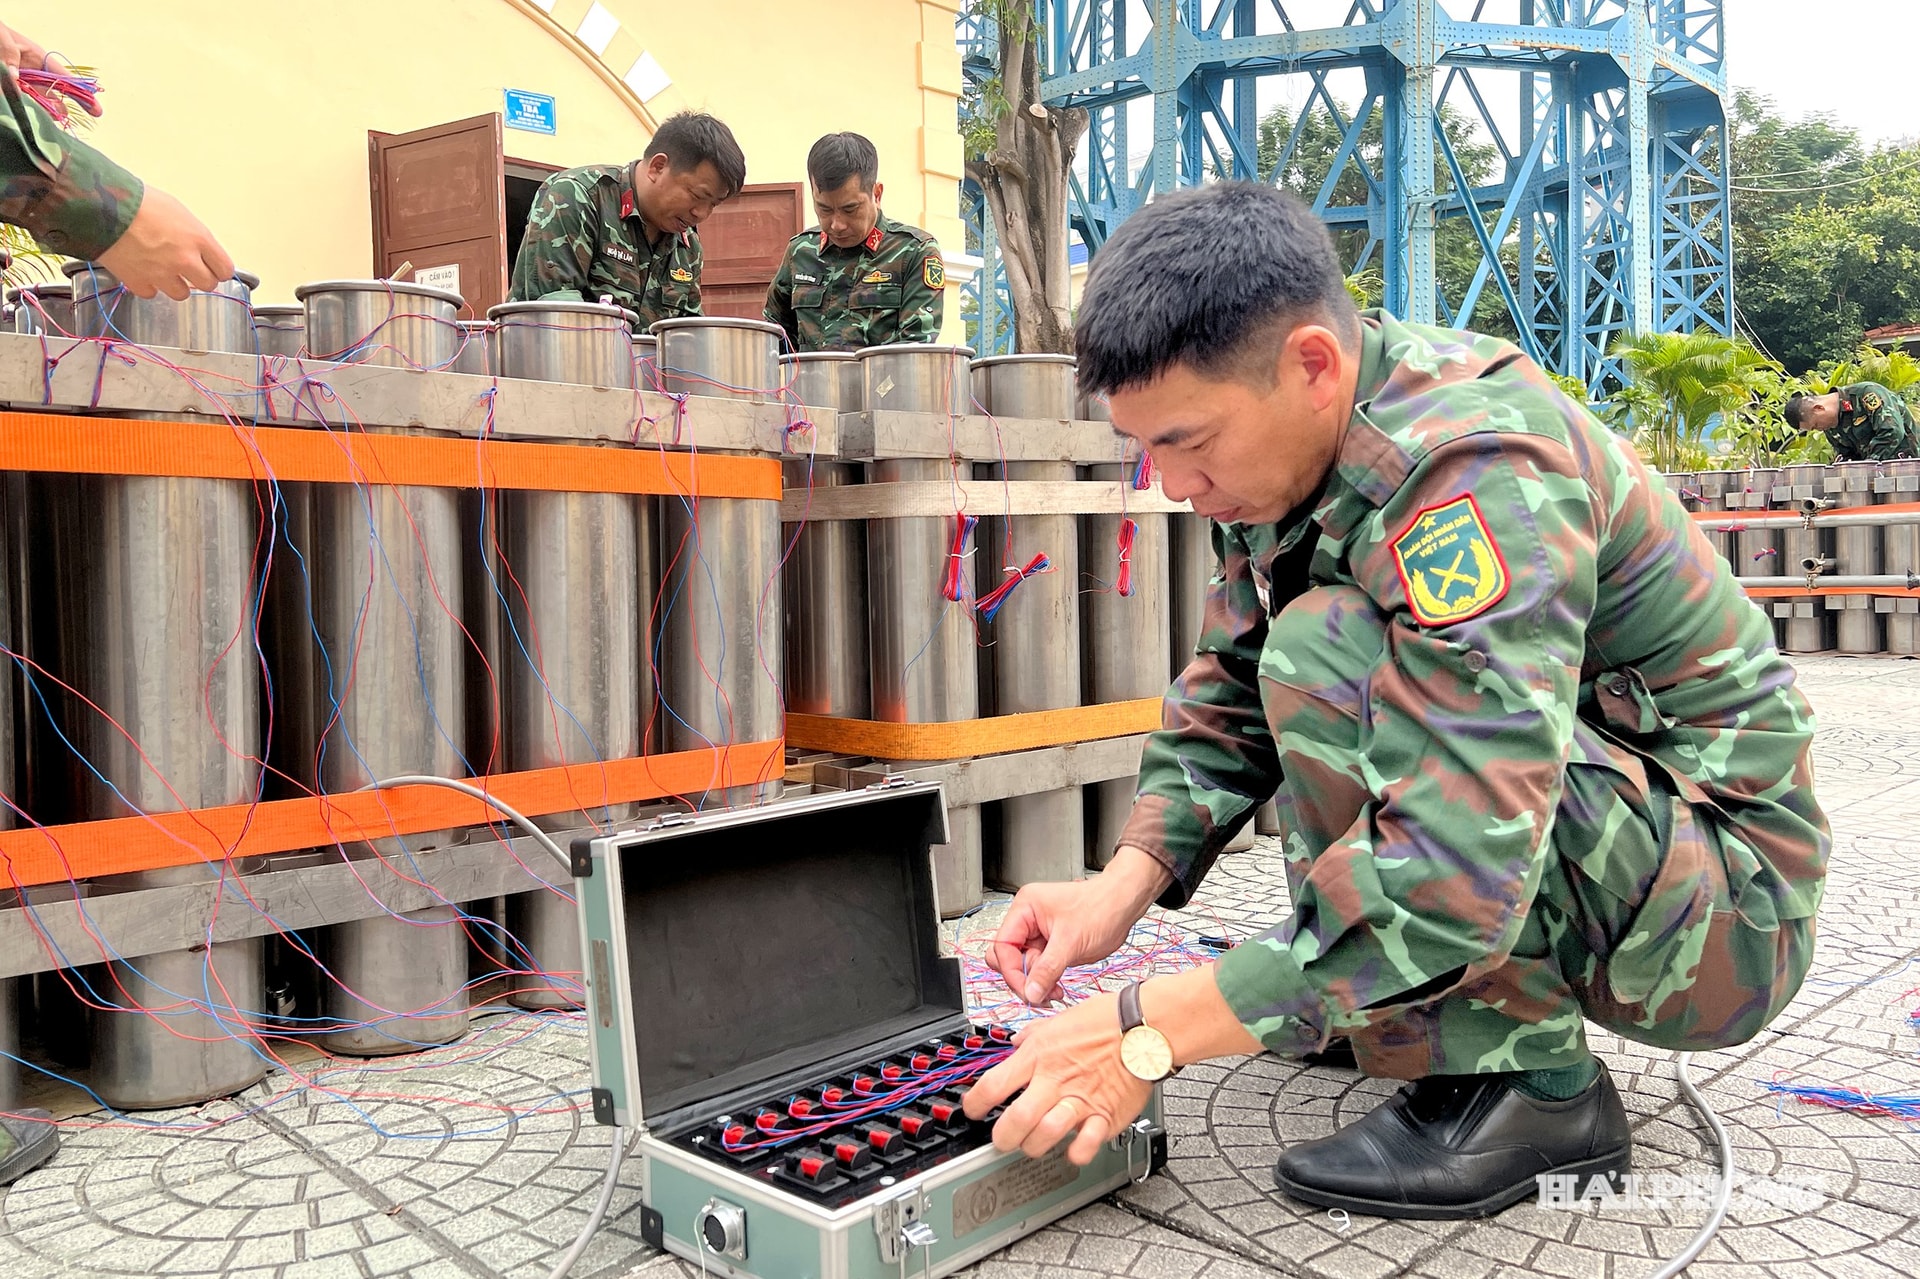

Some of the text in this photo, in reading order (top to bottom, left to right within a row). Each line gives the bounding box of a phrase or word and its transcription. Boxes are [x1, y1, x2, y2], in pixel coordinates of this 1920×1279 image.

[522, 104, 539, 115] TBA
[1404, 515, 1472, 559] QUÂN ĐỘI NHÂN DÂN
[1419, 532, 1459, 558] VIỆT NAM
